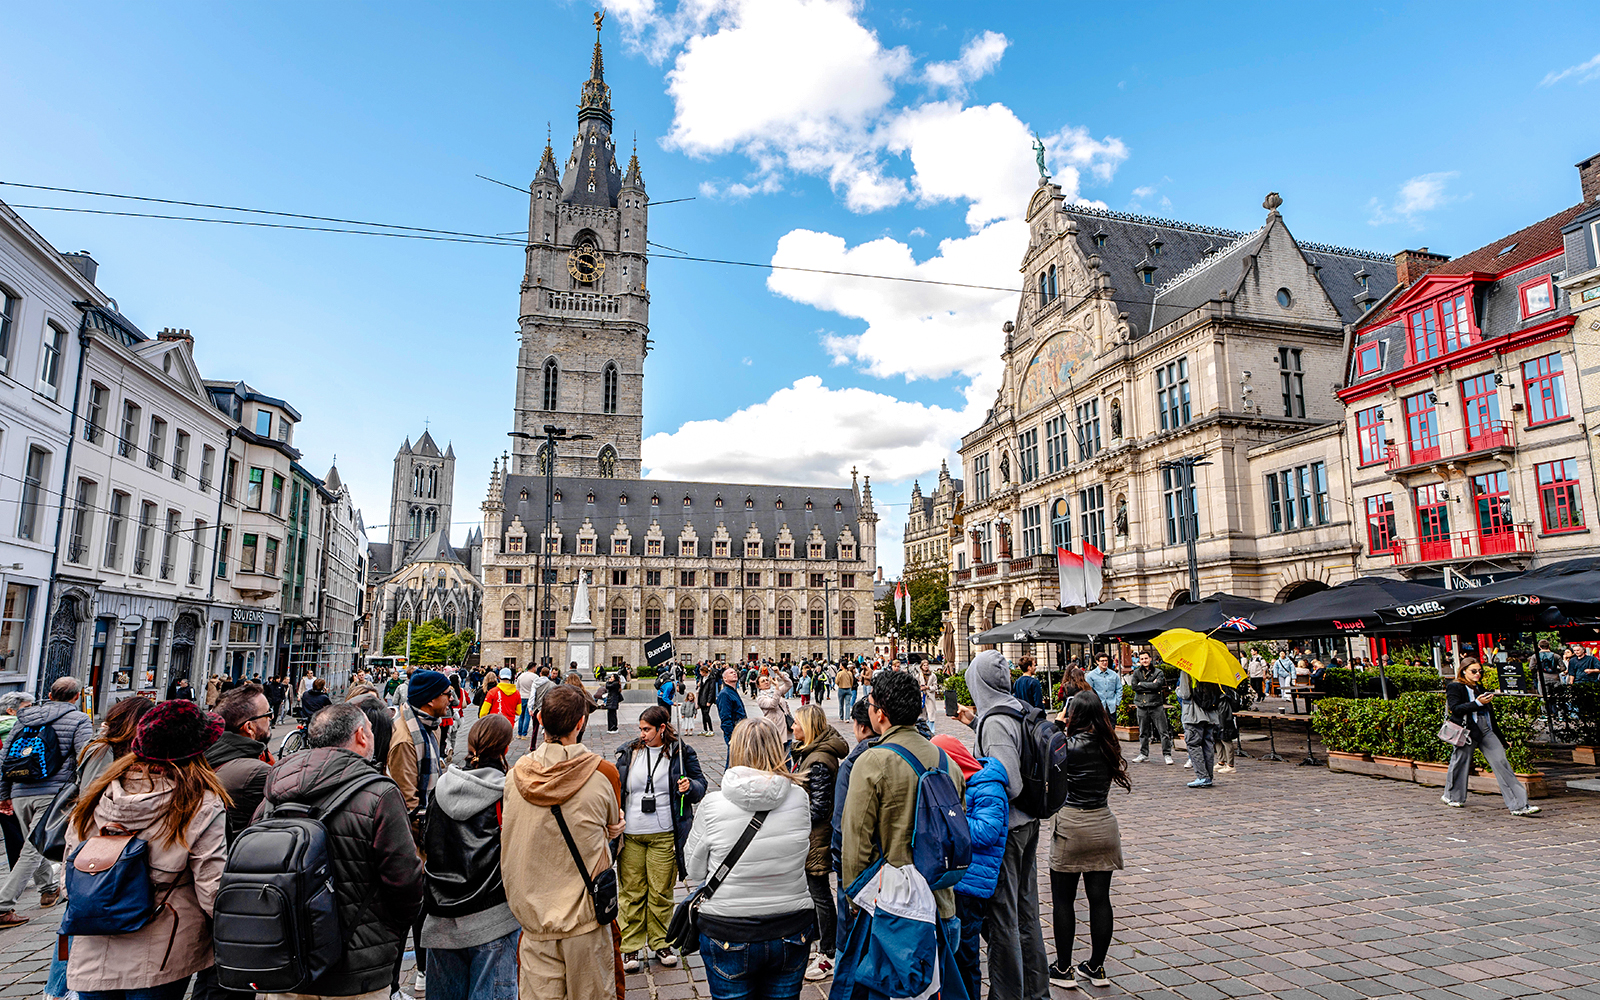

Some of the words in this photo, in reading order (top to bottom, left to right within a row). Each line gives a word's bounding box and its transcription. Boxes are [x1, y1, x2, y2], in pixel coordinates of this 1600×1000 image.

[1332, 619, 1366, 630] Duvel
[1176, 661, 1192, 671] TOUR
[1180, 658, 1193, 667] FREE
